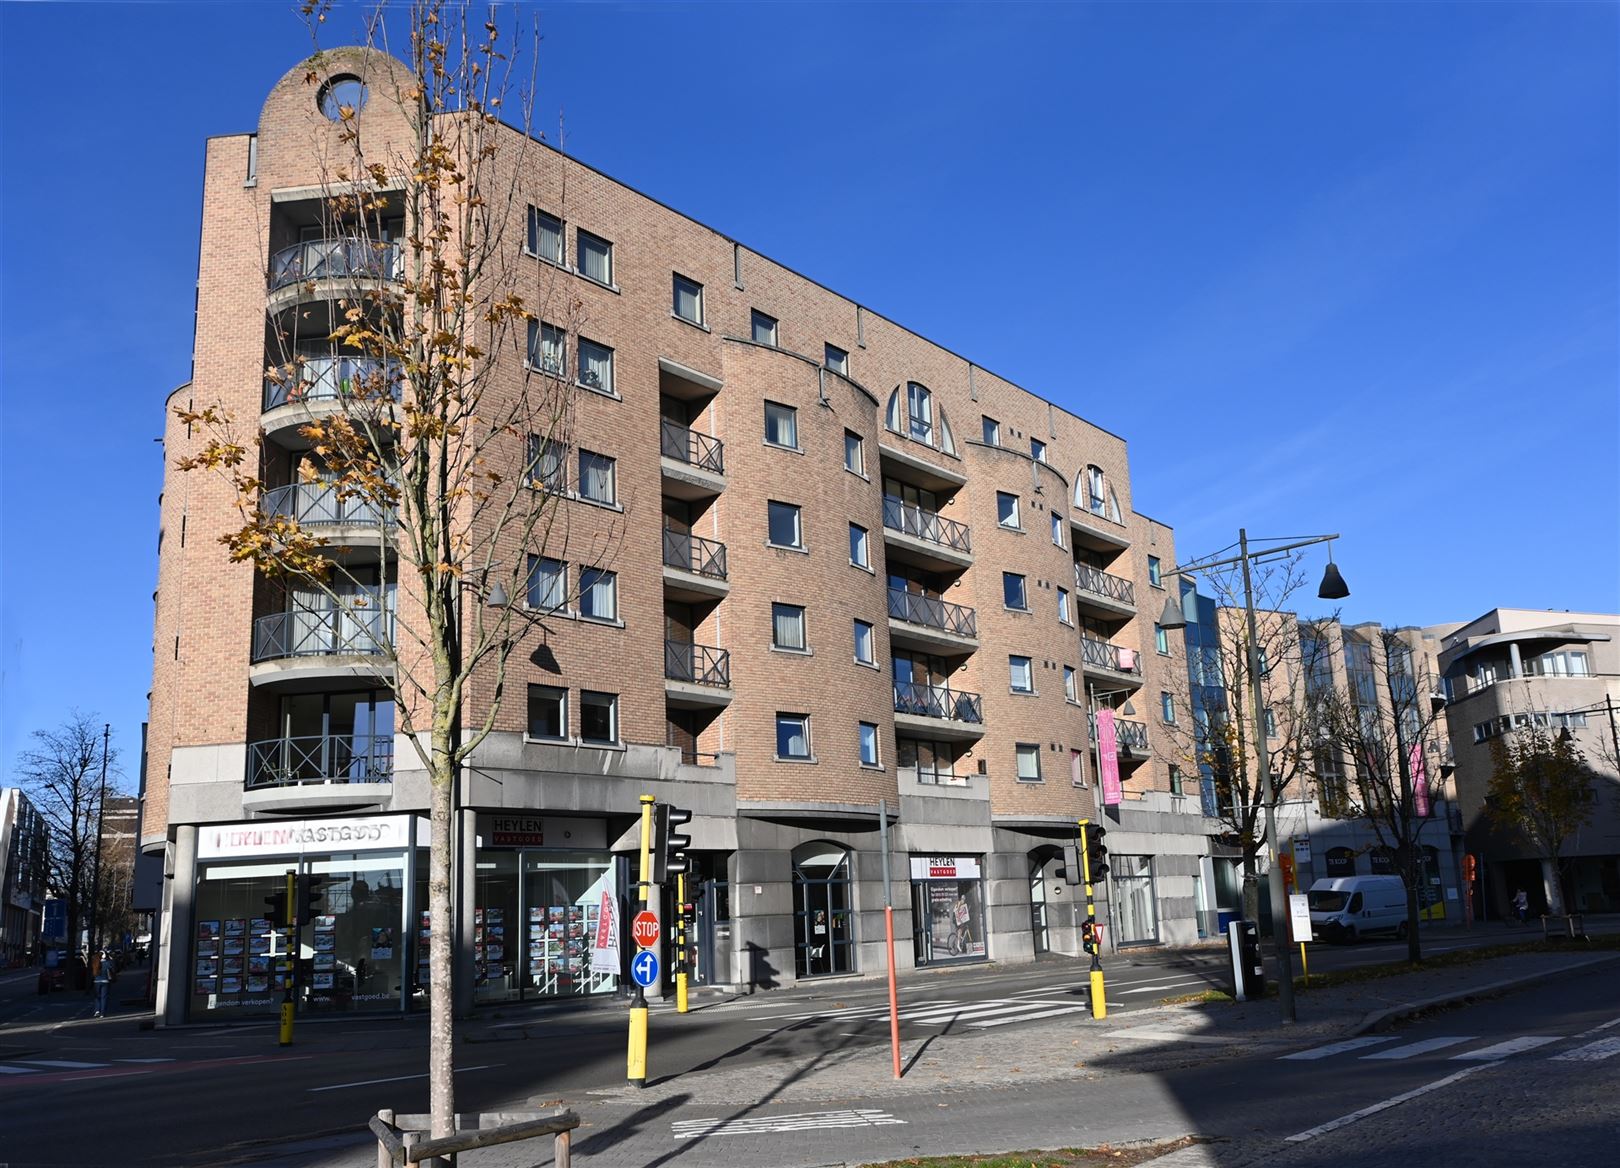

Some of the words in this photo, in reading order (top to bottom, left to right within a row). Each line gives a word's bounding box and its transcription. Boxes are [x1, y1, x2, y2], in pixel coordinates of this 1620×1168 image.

[494, 819, 542, 831] HEYLEN
[929, 857, 955, 866] HEYLEN
[635, 921, 659, 937] STOP
[209, 999, 240, 1008] Egendom
